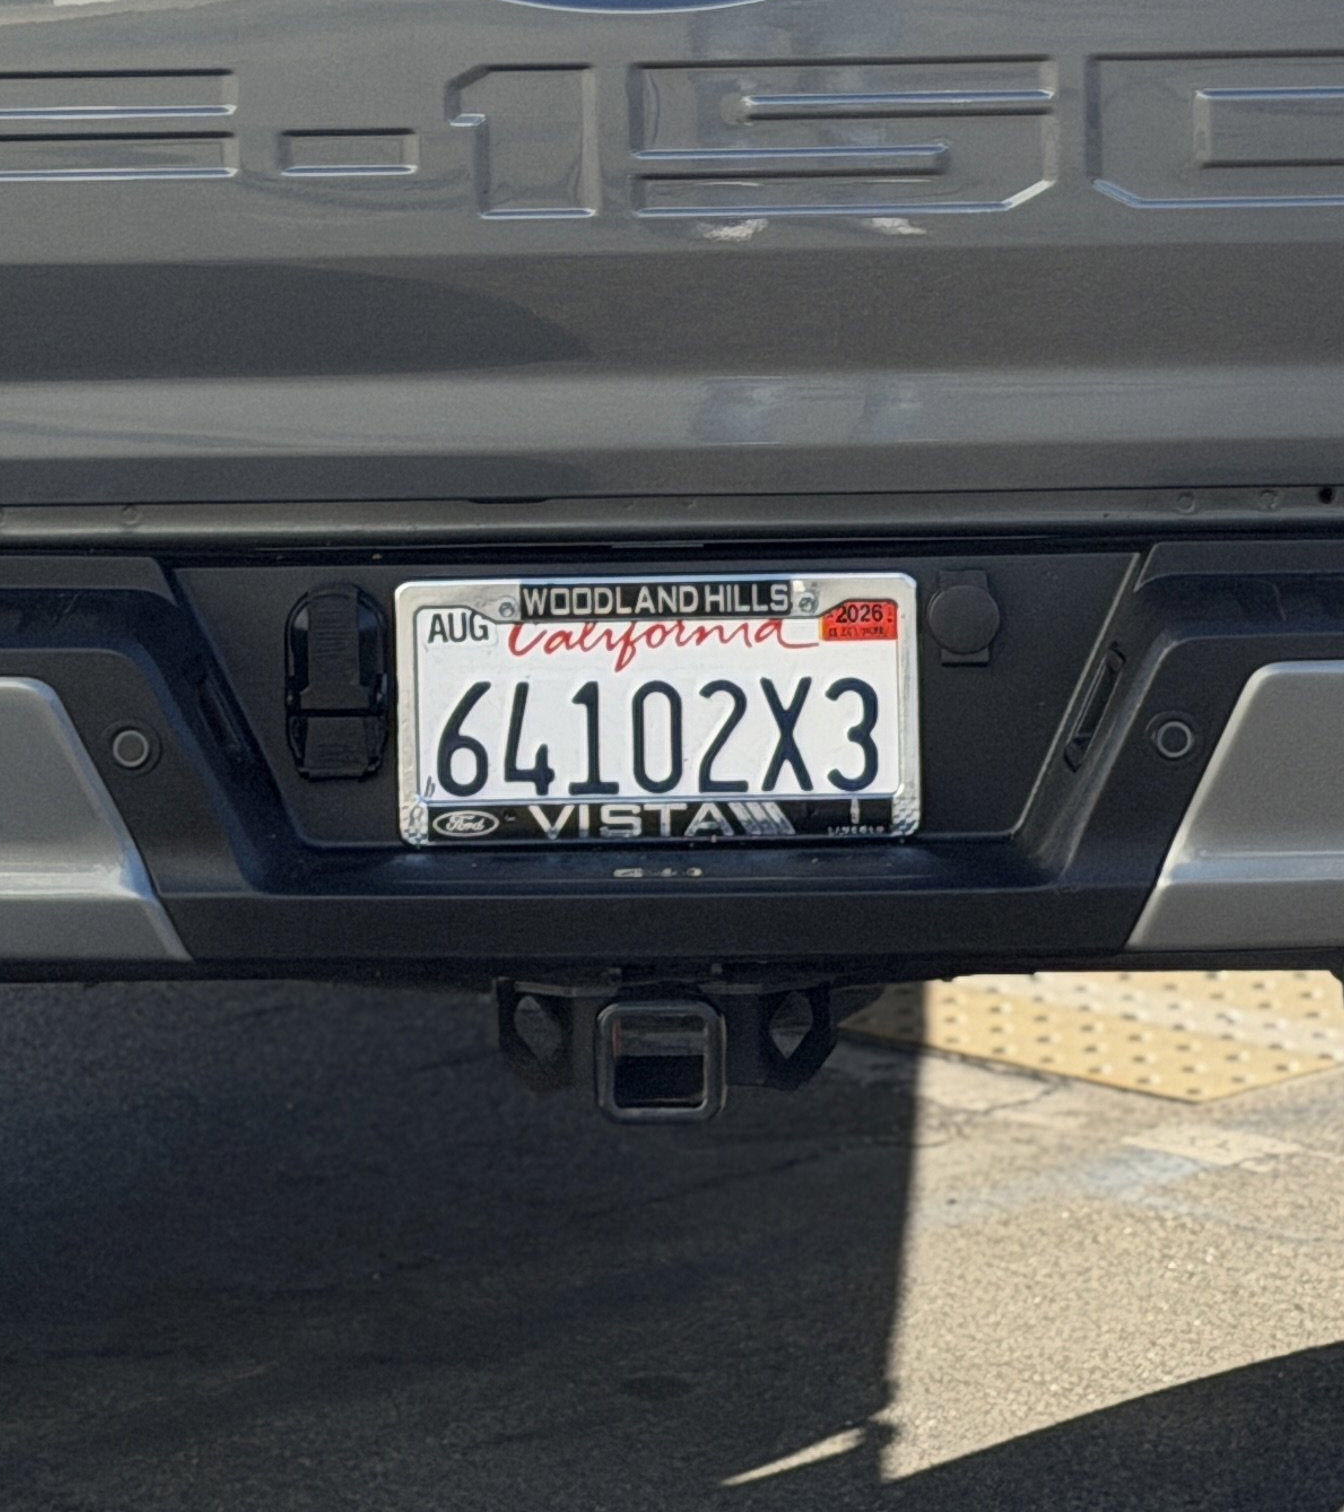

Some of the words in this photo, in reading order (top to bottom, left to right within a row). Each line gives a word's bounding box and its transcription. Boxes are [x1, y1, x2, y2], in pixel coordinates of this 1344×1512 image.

[522, 586, 699, 616] WOODLAND
[707, 584, 790, 613] HILLS
[835, 603, 884, 624] 2026
[427, 612, 490, 644] AUG
[507, 617, 820, 672] California
[436, 676, 879, 796] 64102X3
[527, 802, 735, 839] VISTA
